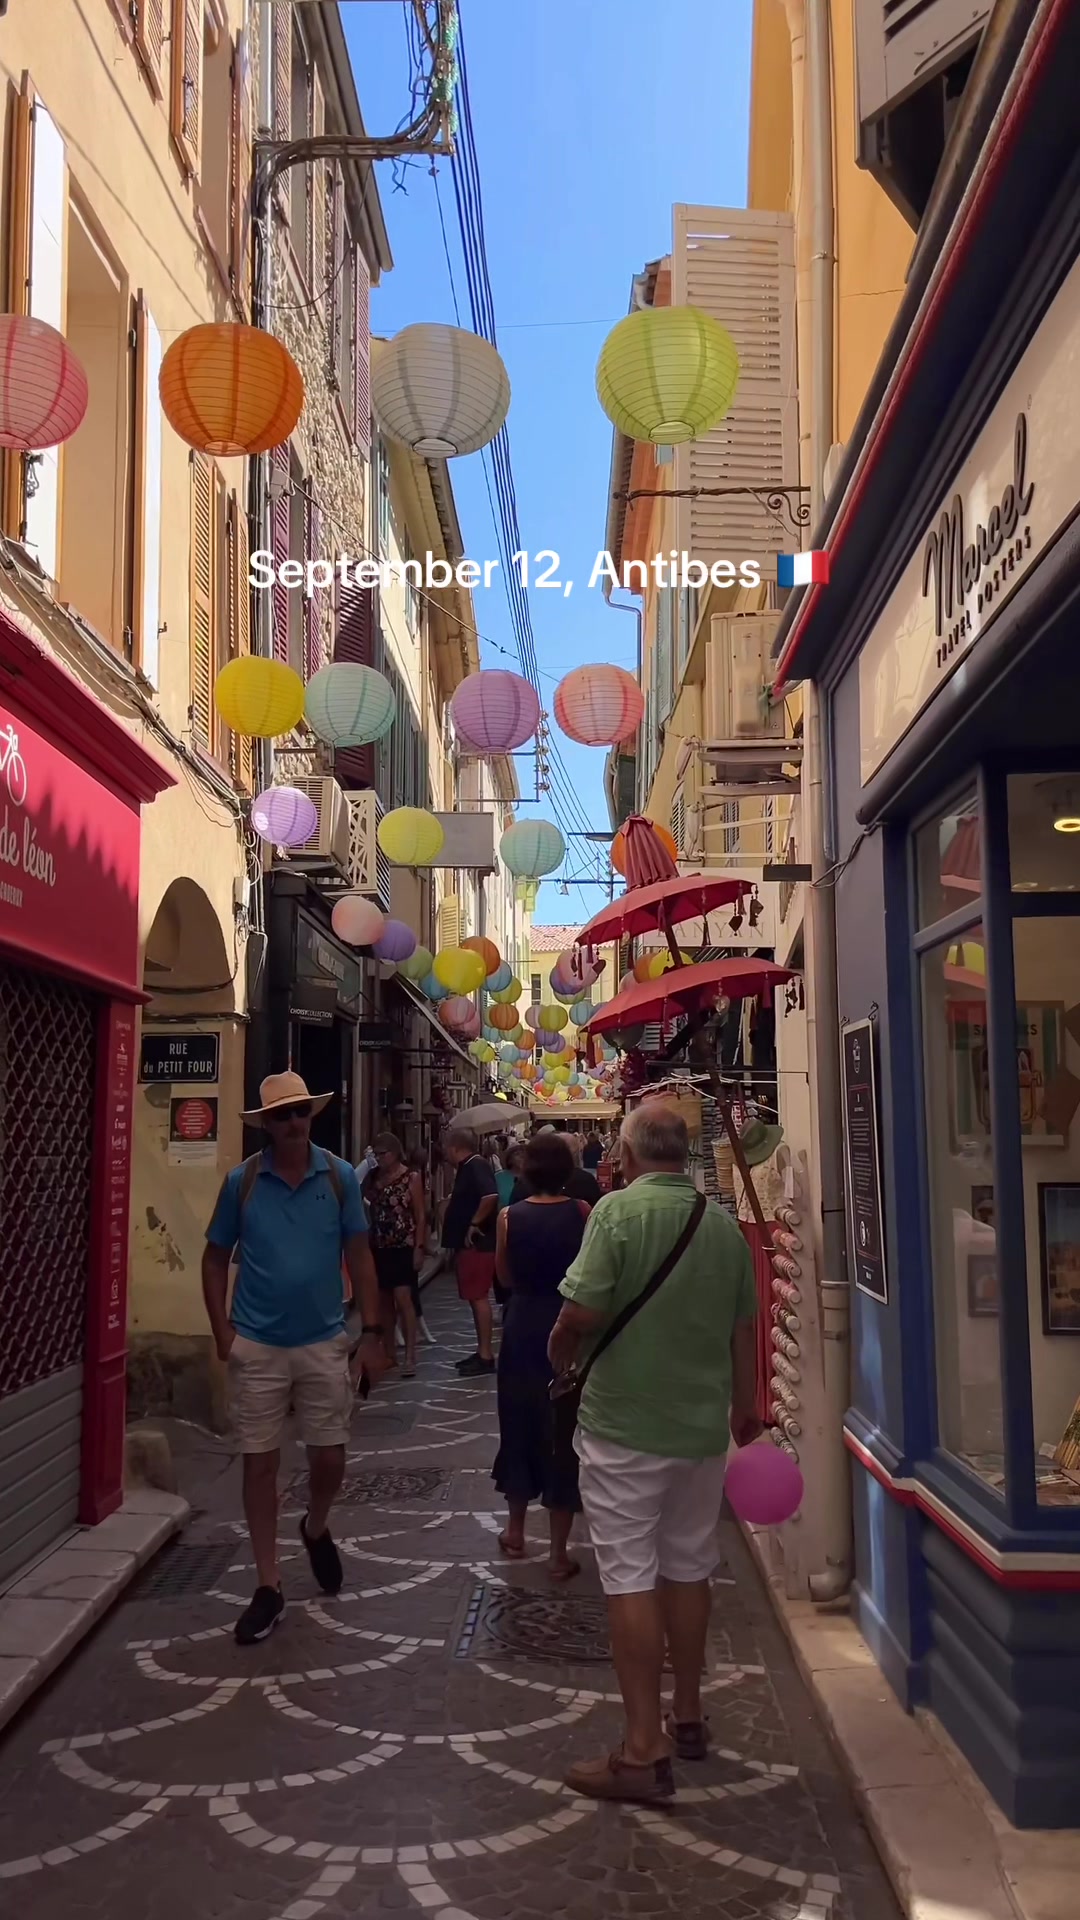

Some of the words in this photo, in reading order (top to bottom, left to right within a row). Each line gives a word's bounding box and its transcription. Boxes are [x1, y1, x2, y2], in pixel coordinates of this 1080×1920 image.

[922, 412, 1035, 637] Marcel
[936, 609, 973, 669] TRAVEL
[977, 525, 1032, 614] POSTERS
[23, 816, 56, 887] léon
[143, 1061, 154, 1073] du
[157, 1061, 184, 1074] PETIT
[187, 1061, 213, 1073] FOUR
[169, 1043, 188, 1055] RUE
